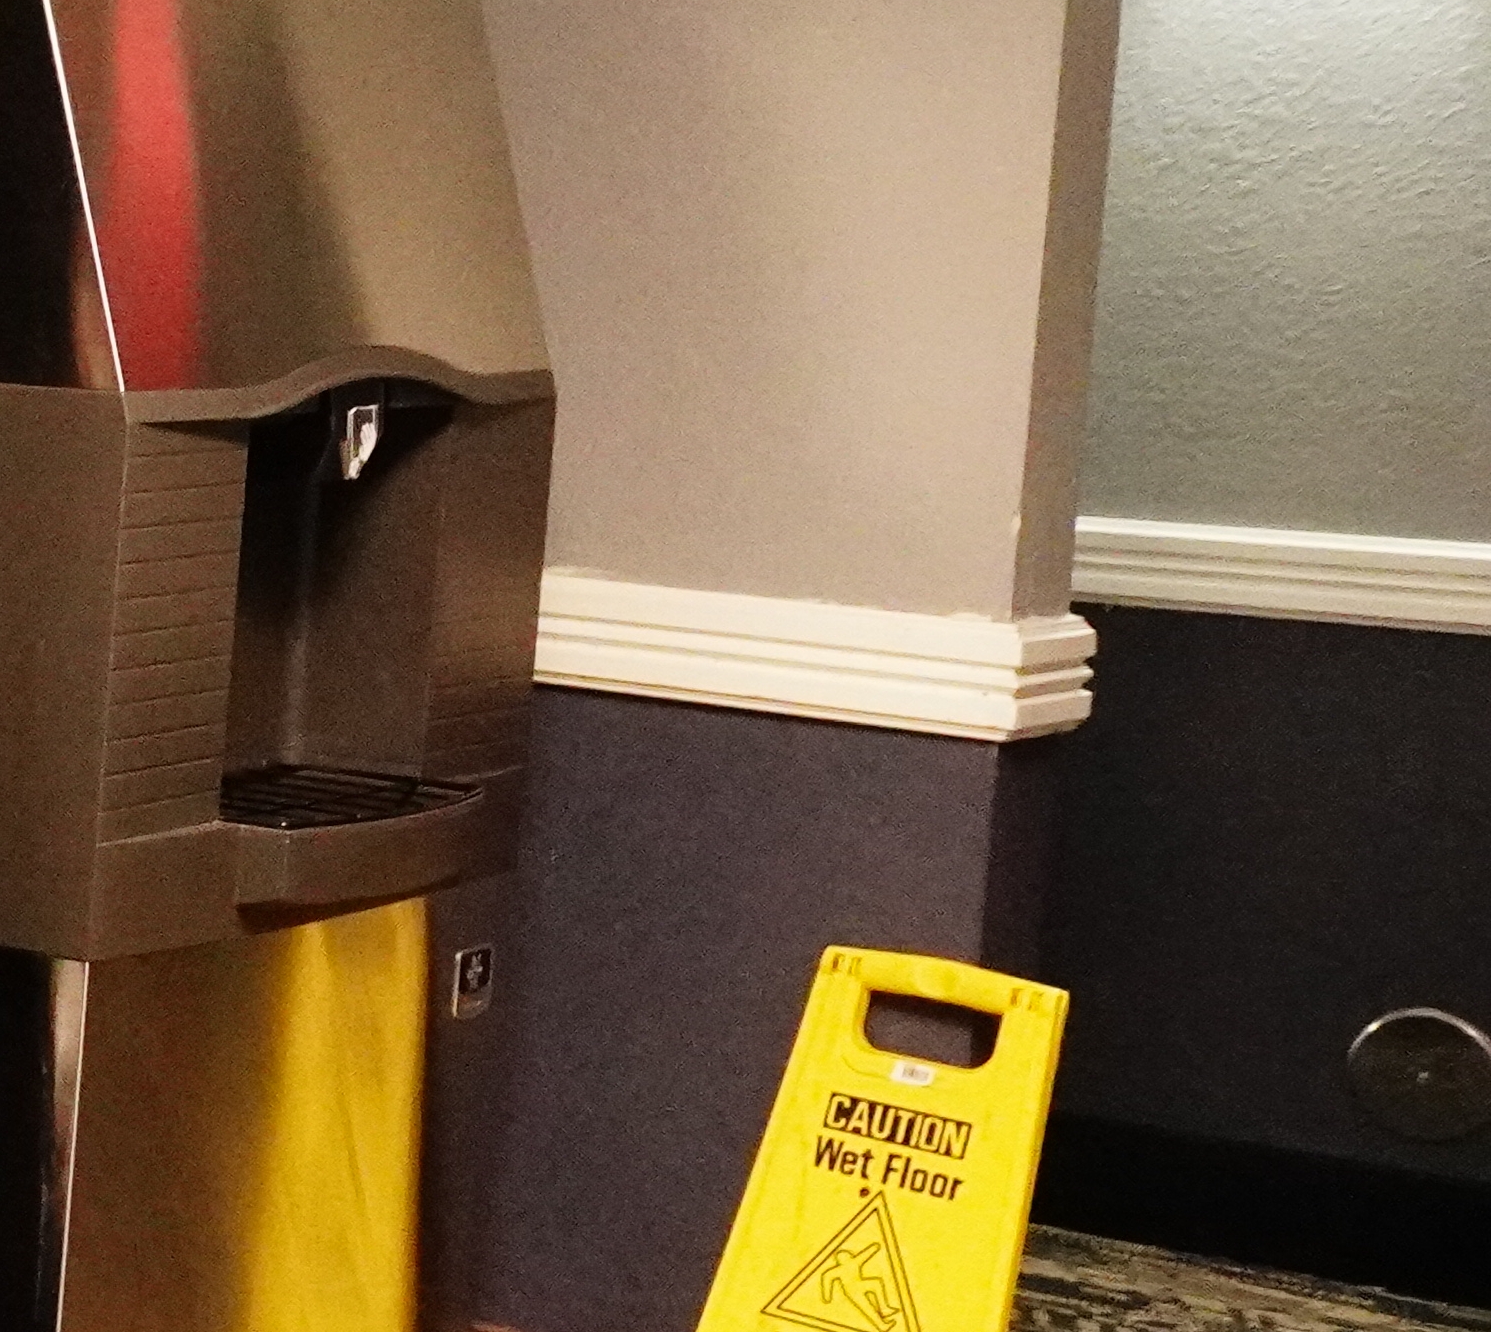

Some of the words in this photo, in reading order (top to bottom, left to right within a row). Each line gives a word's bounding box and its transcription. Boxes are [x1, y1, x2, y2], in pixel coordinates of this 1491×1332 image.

[825, 1094, 971, 1159] CAUTION
[814, 1135, 875, 1181] Wet
[879, 1147, 965, 1203] Floor
